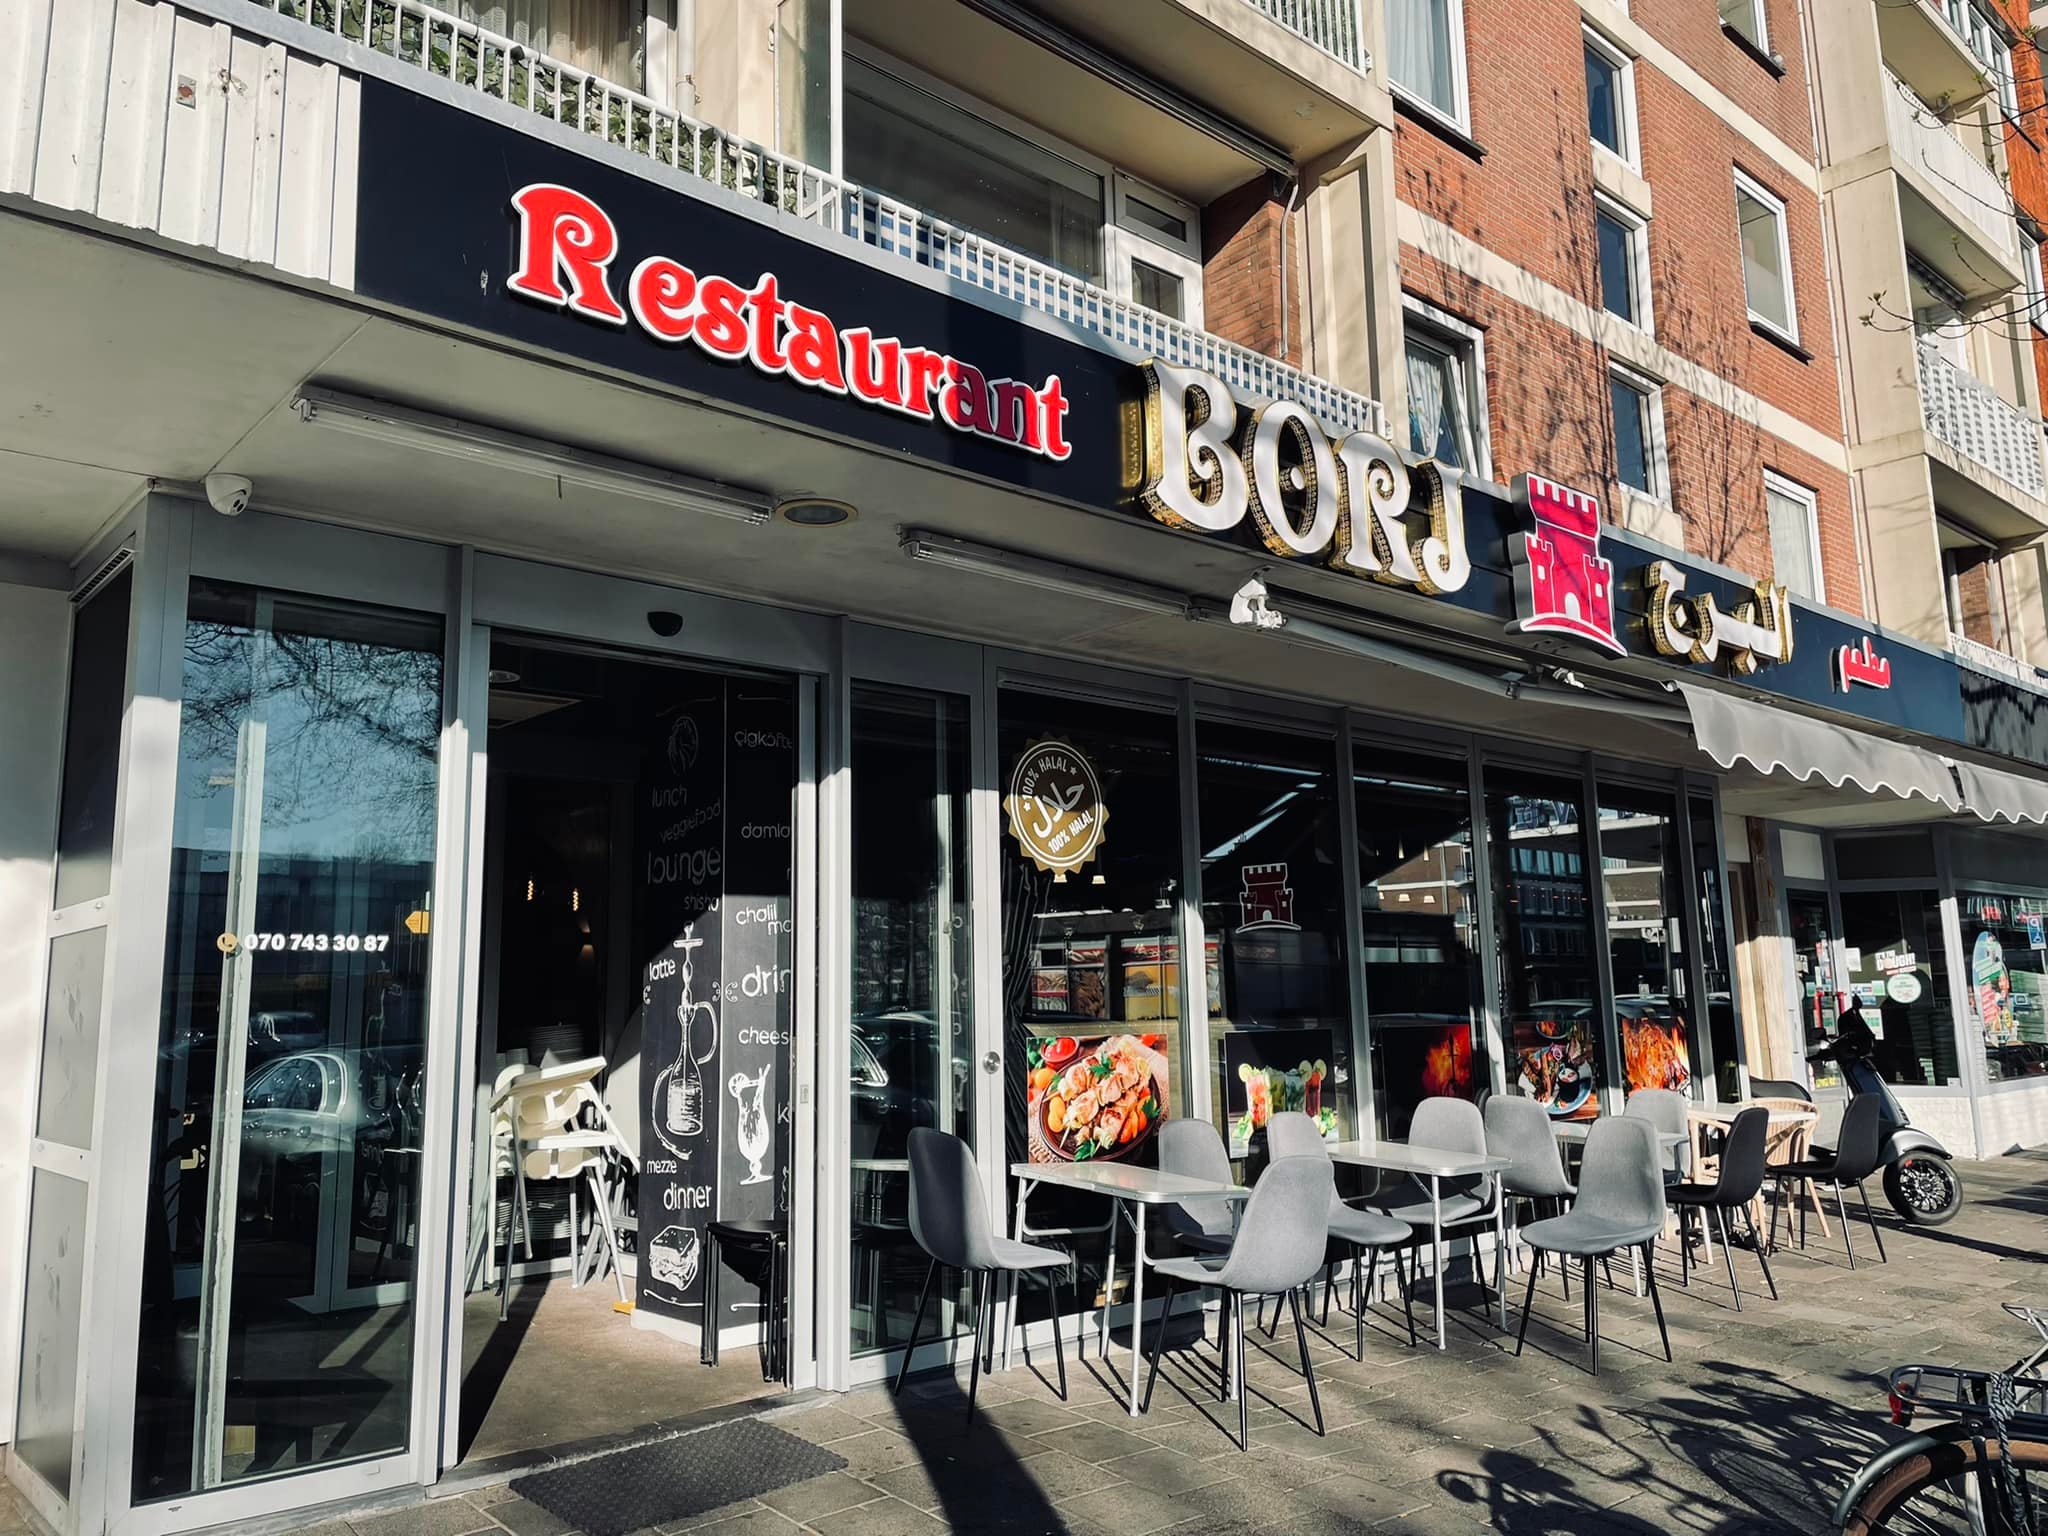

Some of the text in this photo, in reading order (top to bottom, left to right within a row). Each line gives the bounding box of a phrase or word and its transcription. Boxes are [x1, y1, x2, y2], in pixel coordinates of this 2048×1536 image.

[507, 182, 1072, 461] Restaurant
[1141, 357, 1471, 594] BORJ
[1647, 560, 1794, 674] البرج
[1836, 635, 1891, 693] مطعم
[651, 784, 688, 808] lunch
[1022, 756, 1067, 800] 100% HALAL
[1033, 782, 1085, 838] حلال
[1048, 810, 1094, 854] 100% HALAL
[647, 846, 721, 886] lounge
[244, 933, 390, 952] 070 743 30 87
[649, 958, 676, 982] latte
[646, 1159, 678, 1175] mezze
[663, 1181, 713, 1211] dinner
